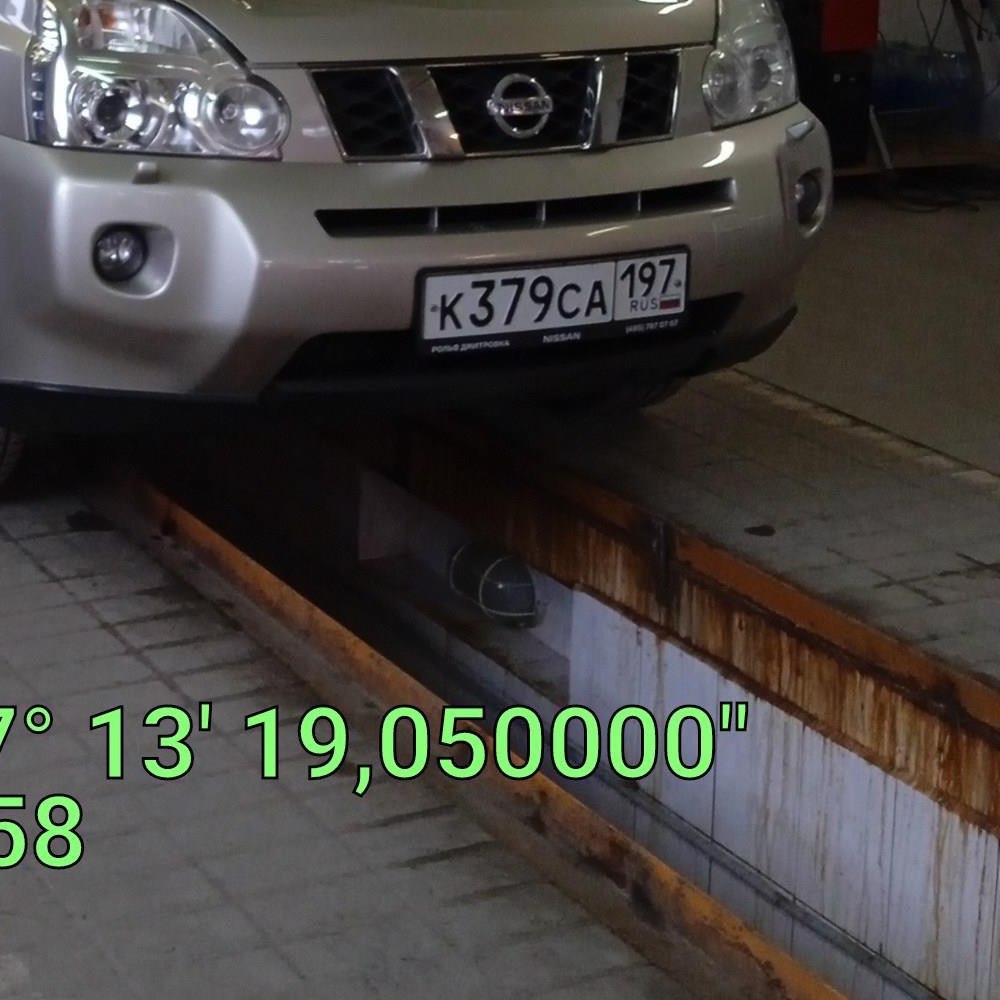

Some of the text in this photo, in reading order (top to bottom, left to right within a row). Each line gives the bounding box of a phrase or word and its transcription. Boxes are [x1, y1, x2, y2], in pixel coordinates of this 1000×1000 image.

[619, 258, 677, 299] 197
[630, 299, 658, 313] RUS
[542, 331, 582, 344] NISSAN
